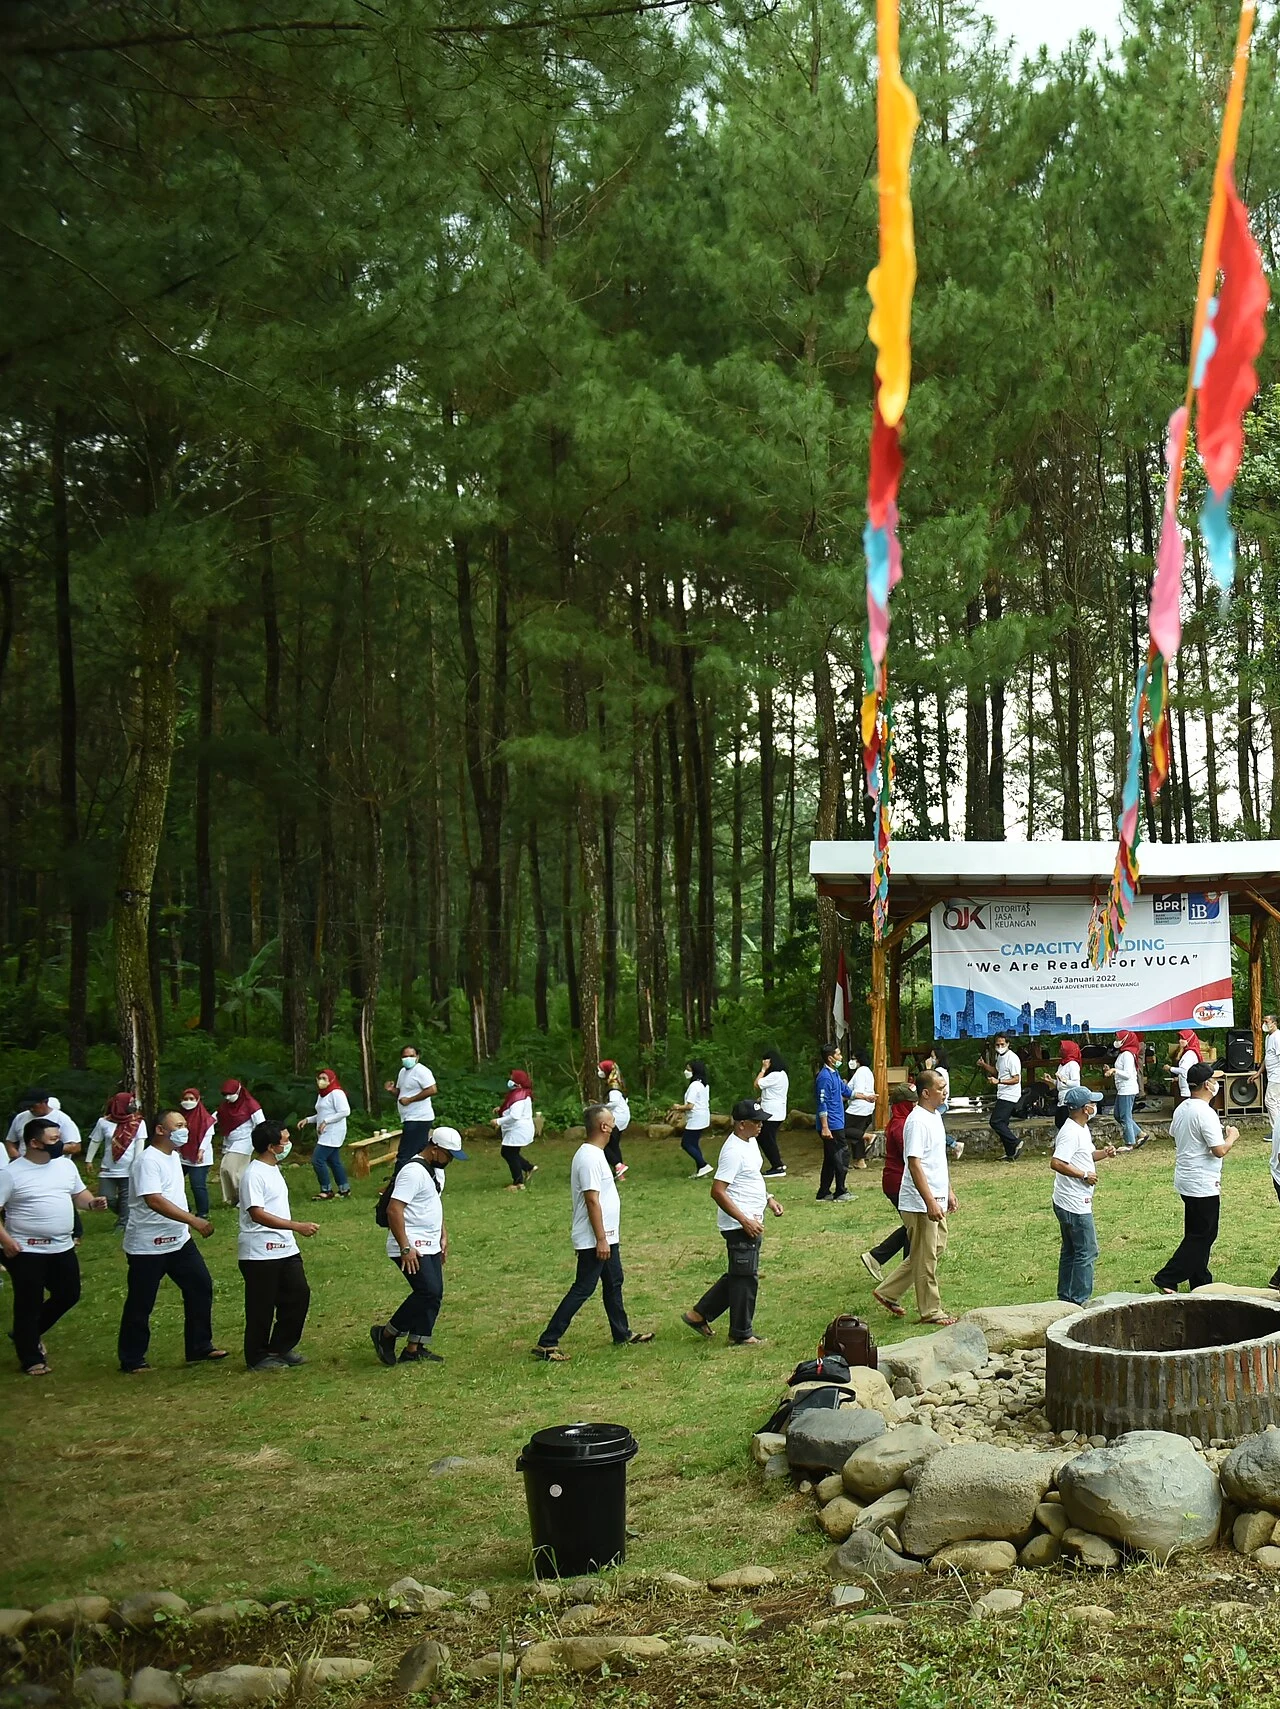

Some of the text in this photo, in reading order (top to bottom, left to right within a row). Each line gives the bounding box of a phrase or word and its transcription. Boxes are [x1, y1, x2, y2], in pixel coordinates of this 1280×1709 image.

[994, 905, 1031, 913] OTORITAS
[1155, 901, 1180, 911] BPR
[1191, 904, 1208, 919] iB
[994, 913, 1013, 921] JASA
[994, 920, 1037, 928] KEUANGAN
[1000, 941, 1083, 956] CAPACITY
[1009, 961, 1039, 972] Are
[1047, 958, 1098, 971] Read
[1109, 958, 1136, 968] For
[1052, 974, 1116, 984] 26 Januari 2022
